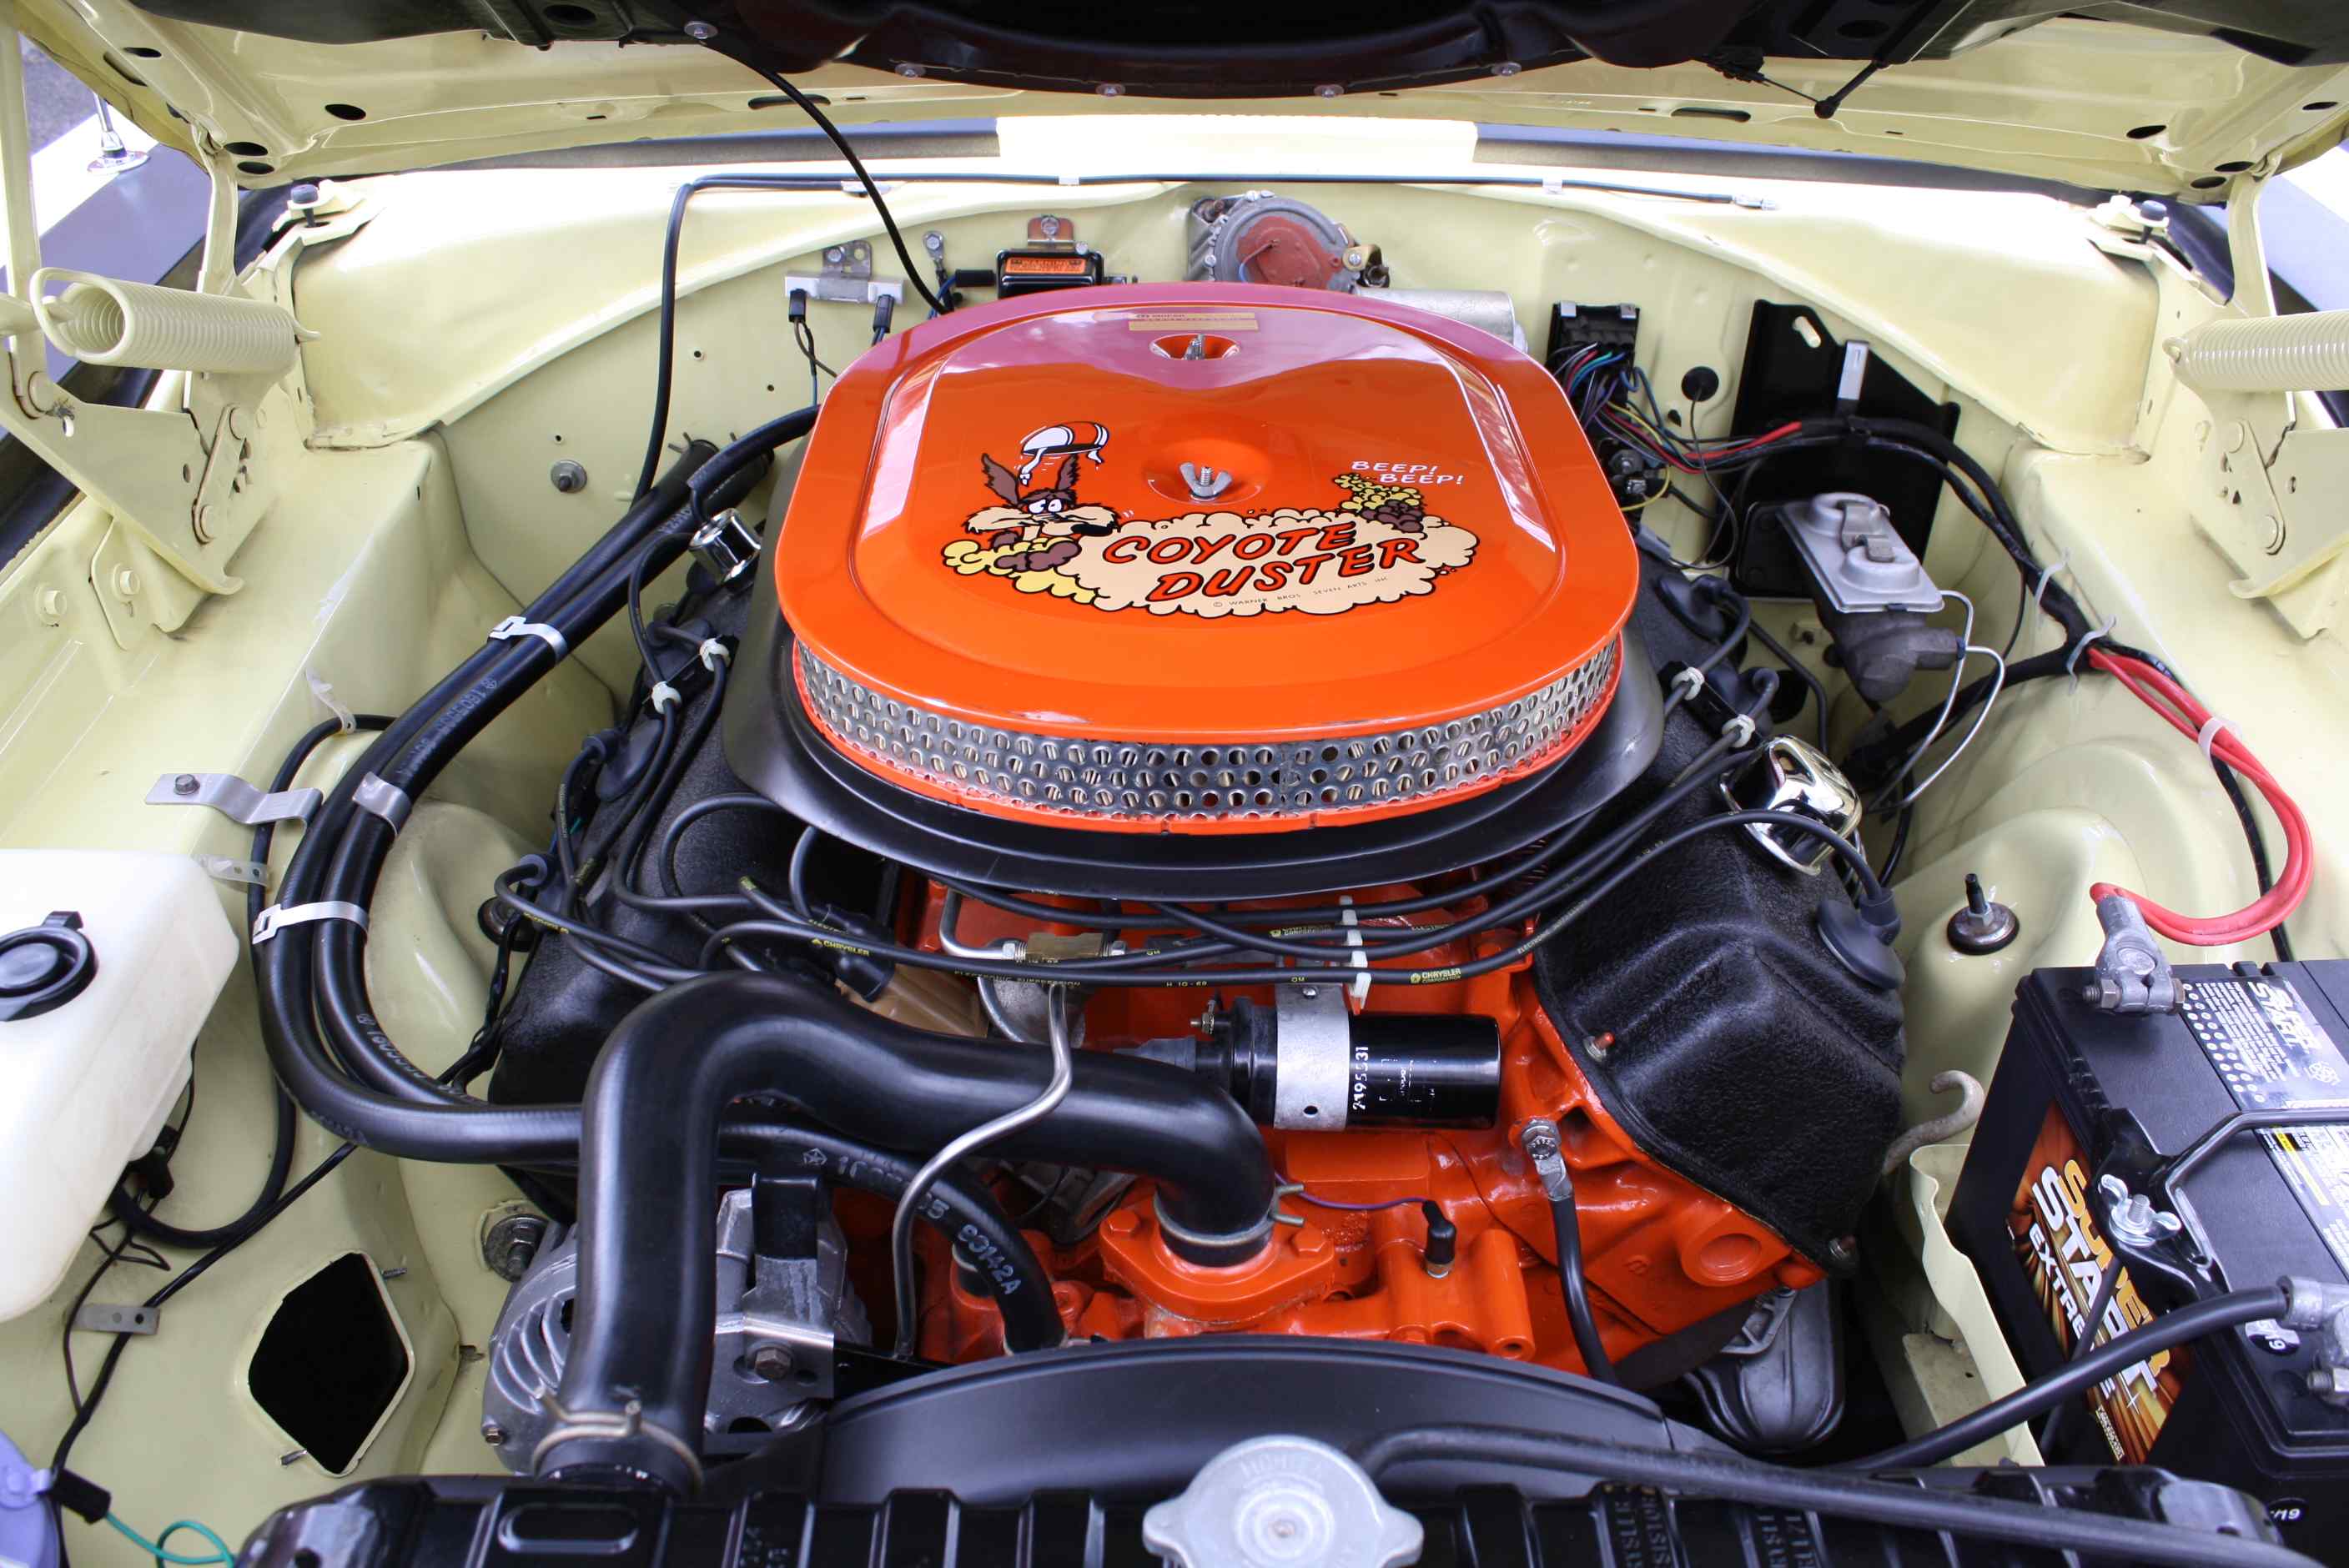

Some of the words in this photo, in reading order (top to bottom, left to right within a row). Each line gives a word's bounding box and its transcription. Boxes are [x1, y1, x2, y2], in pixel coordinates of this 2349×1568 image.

[1351, 460, 1438, 475] BEEP!
[1380, 473, 1464, 485] BEEP!
[1102, 520, 1356, 565] COYOTE
[1144, 537, 1426, 602] DUSTER
[1229, 597, 1268, 606] WARNER
[822, 941, 869, 957] CHRYSLER
[1421, 967, 1461, 979] CHRYSLER
[2246, 981, 2309, 1053] START
[2028, 1222, 2116, 1400] EXTREE
